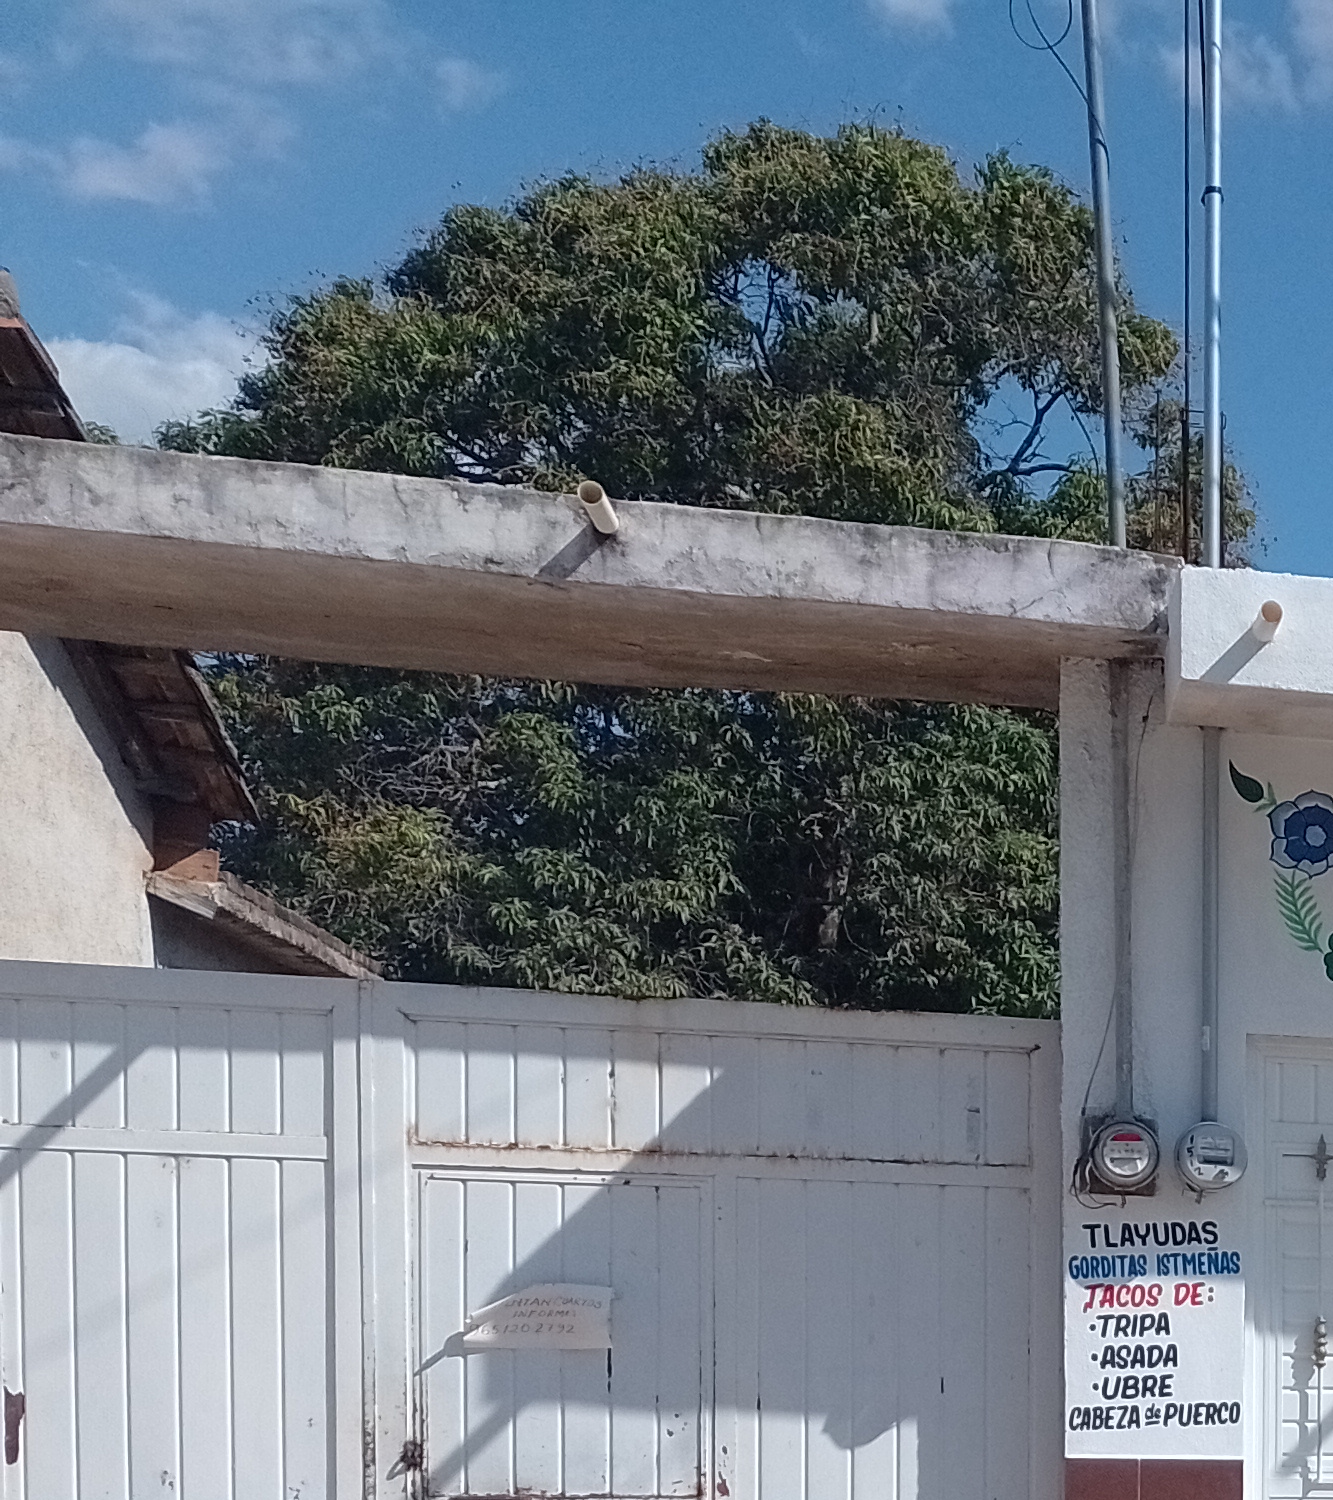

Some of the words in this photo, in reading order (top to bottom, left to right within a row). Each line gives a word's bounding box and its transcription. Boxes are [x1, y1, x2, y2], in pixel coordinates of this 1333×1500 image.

[1081, 1220, 1219, 1249] TLAYUDAS
[1068, 1253, 1148, 1280] GORDITAS
[1156, 1247, 1241, 1277] ISTMEÑAS
[1083, 1282, 1163, 1313] TACOS
[1173, 1281, 1215, 1306] DE:
[1096, 1312, 1171, 1338] TRIPA
[1100, 1343, 1178, 1369] ASADA
[1101, 1373, 1175, 1400] UBRE
[1068, 1404, 1141, 1431] CABEZA
[1144, 1402, 1162, 1427] de
[1163, 1401, 1241, 1428] PUERCO
